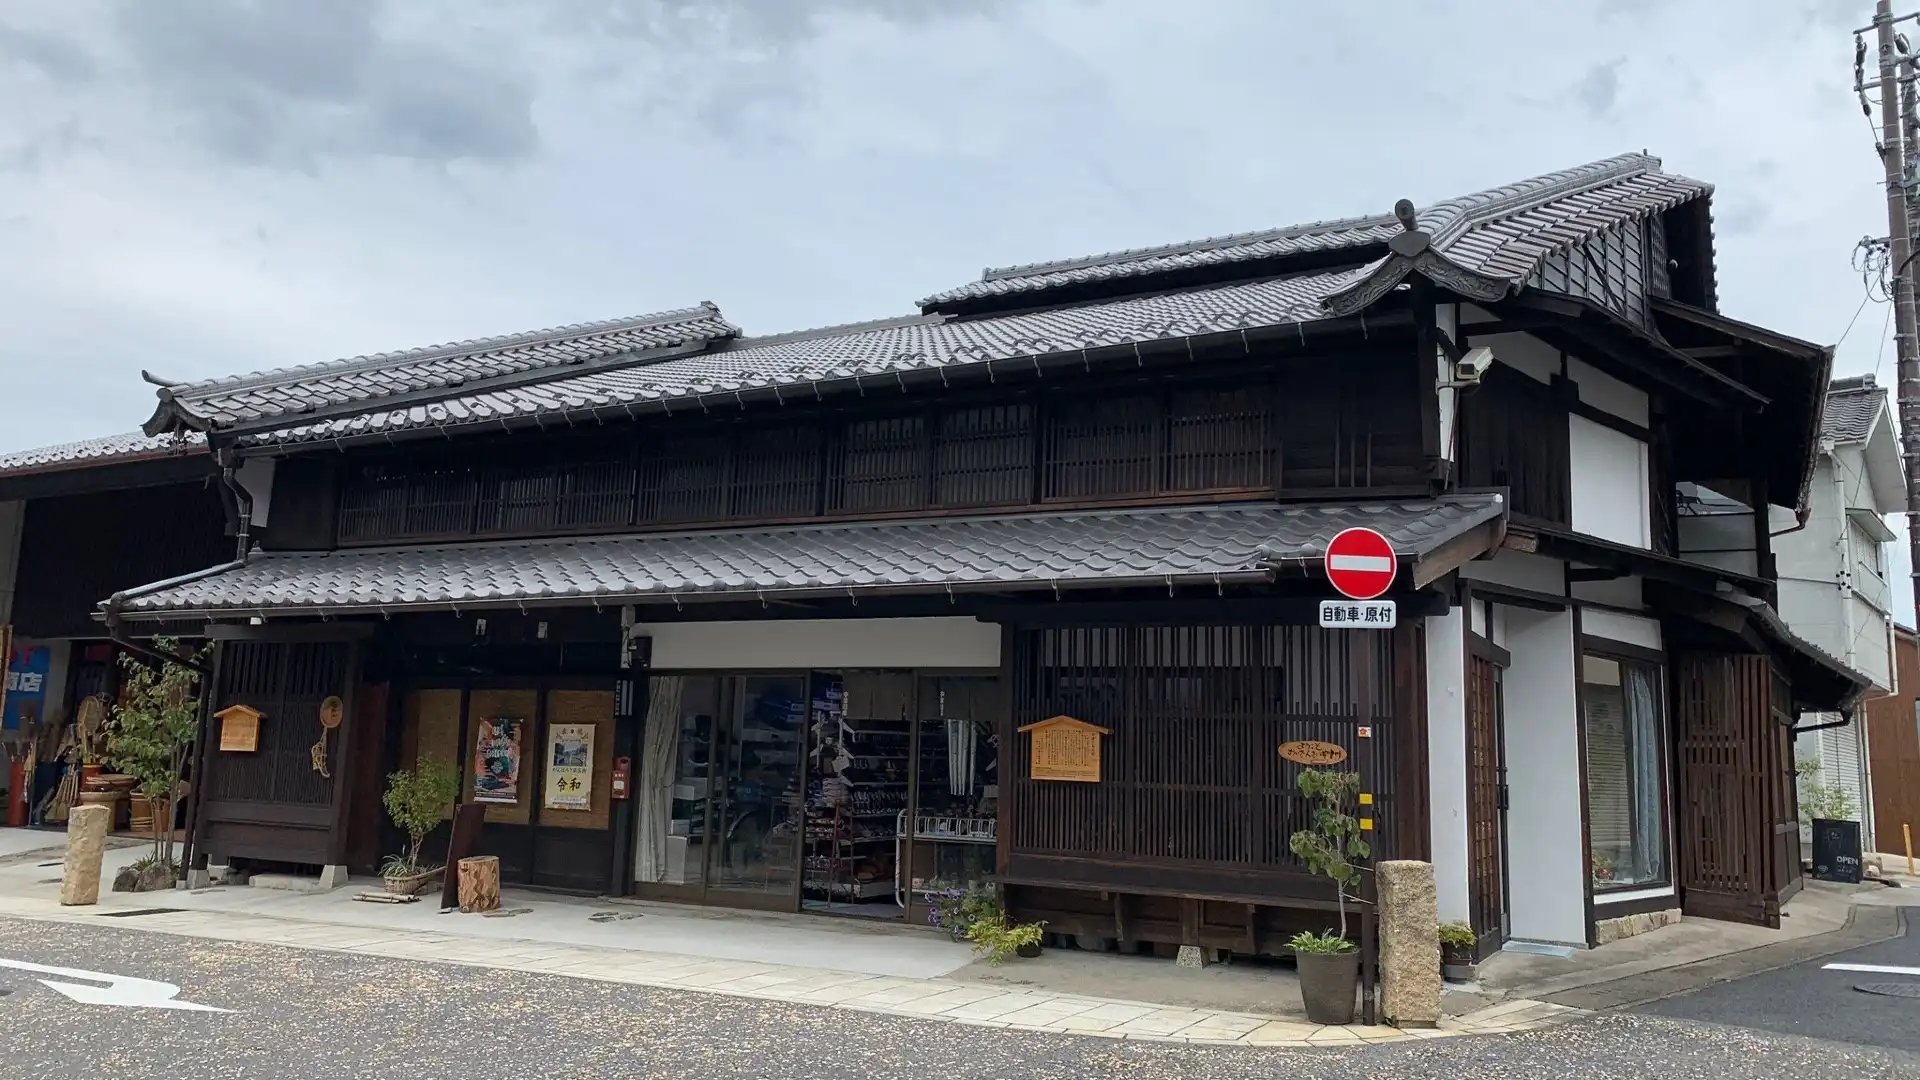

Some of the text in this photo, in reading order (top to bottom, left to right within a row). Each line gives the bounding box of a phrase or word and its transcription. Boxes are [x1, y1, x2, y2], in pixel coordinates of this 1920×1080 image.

[1323, 606, 1392, 623] 自動車・原付
[556, 776, 582, 792] 令和
[1836, 856, 1858, 865] OPEN
